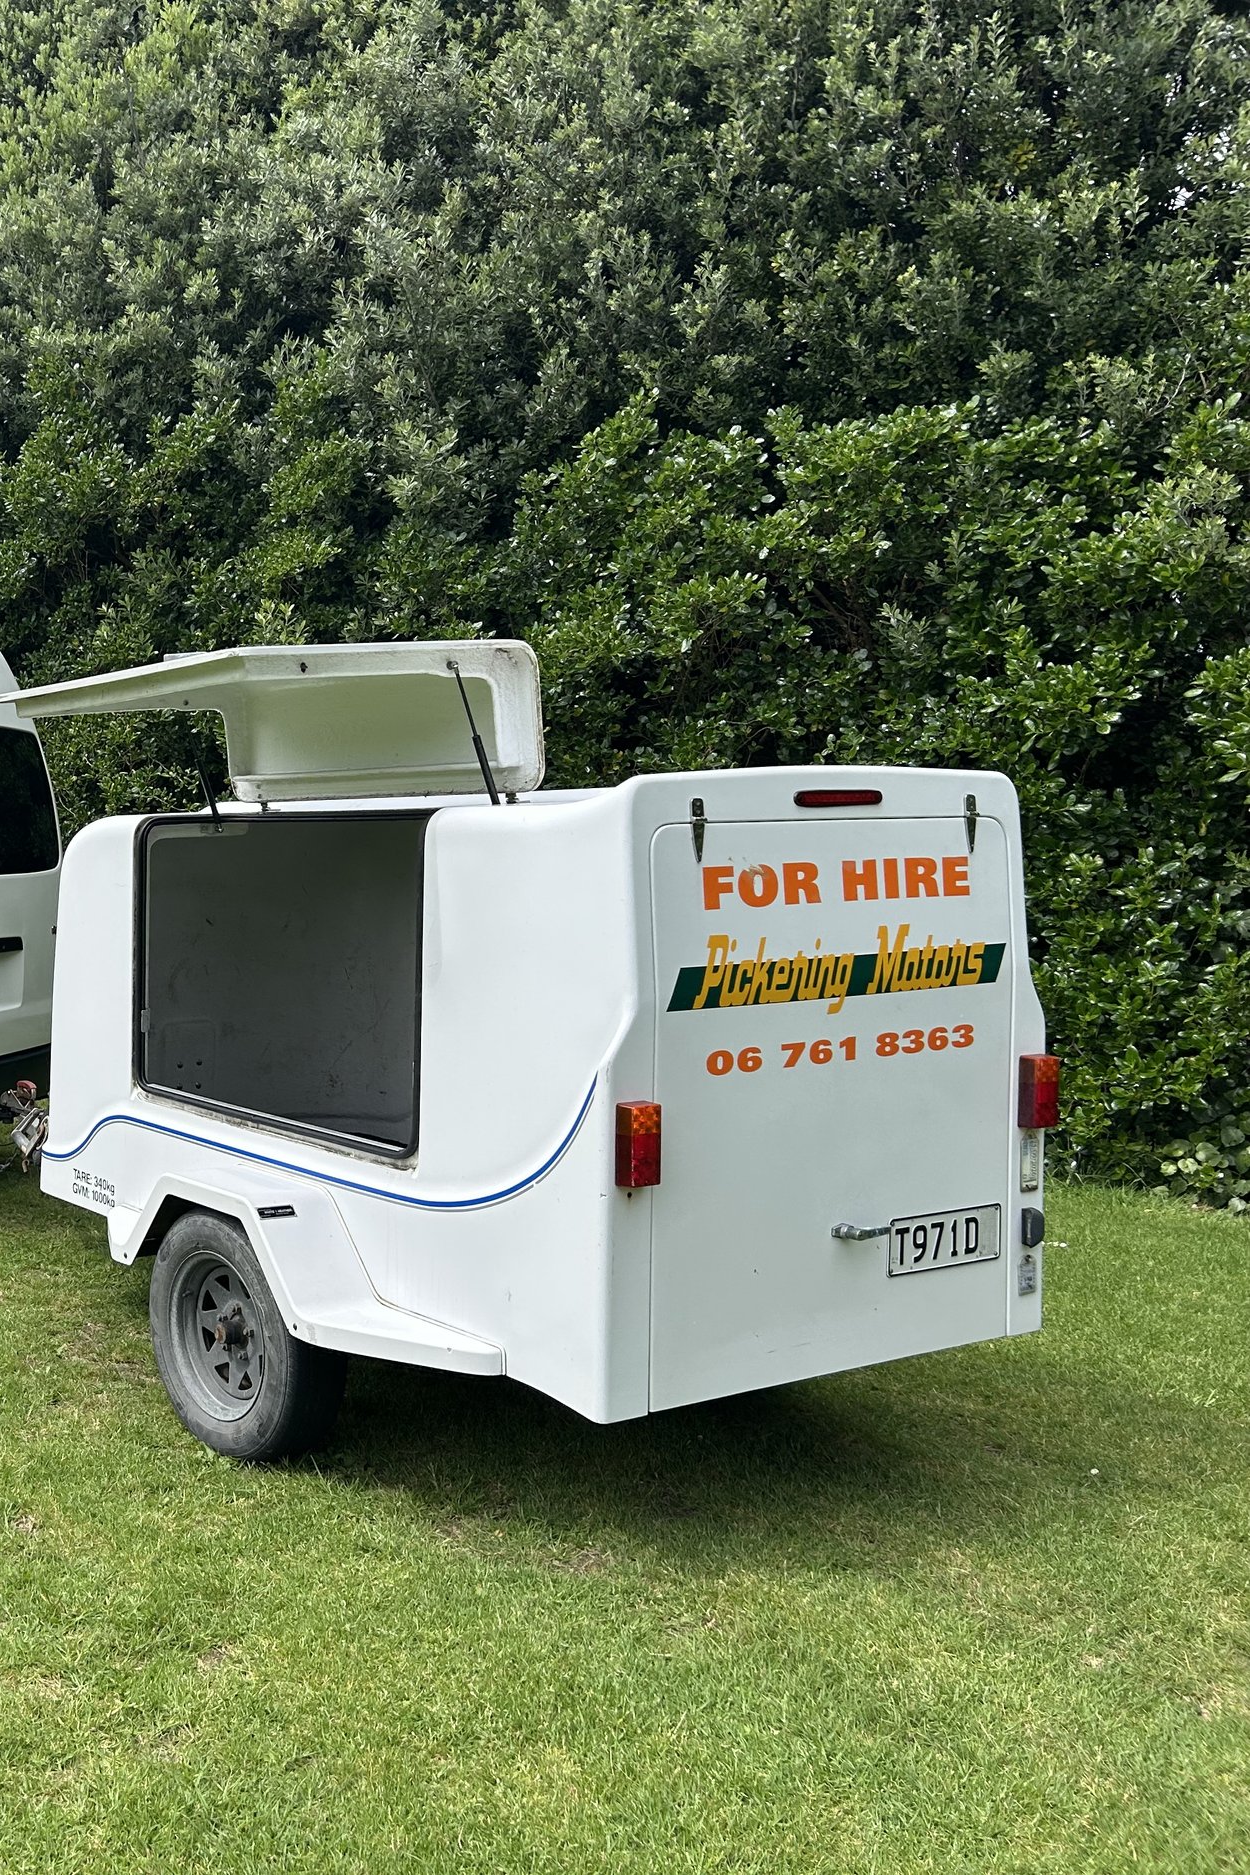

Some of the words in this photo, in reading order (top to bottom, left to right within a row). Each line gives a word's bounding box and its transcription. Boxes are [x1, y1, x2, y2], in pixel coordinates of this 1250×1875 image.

[702, 861, 822, 910] FOR
[841, 856, 971, 902] HIRE
[692, 934, 855, 1015] Pickering
[866, 924, 985, 995] Motors
[706, 1046, 763, 1076] 06
[781, 1036, 856, 1068] 761
[875, 1024, 974, 1057] 8363
[72, 1168, 92, 1185] TARE:
[93, 1176, 115, 1196] 340kg
[72, 1182, 90, 1199] GVM:
[895, 1217, 979, 1265] T971D
